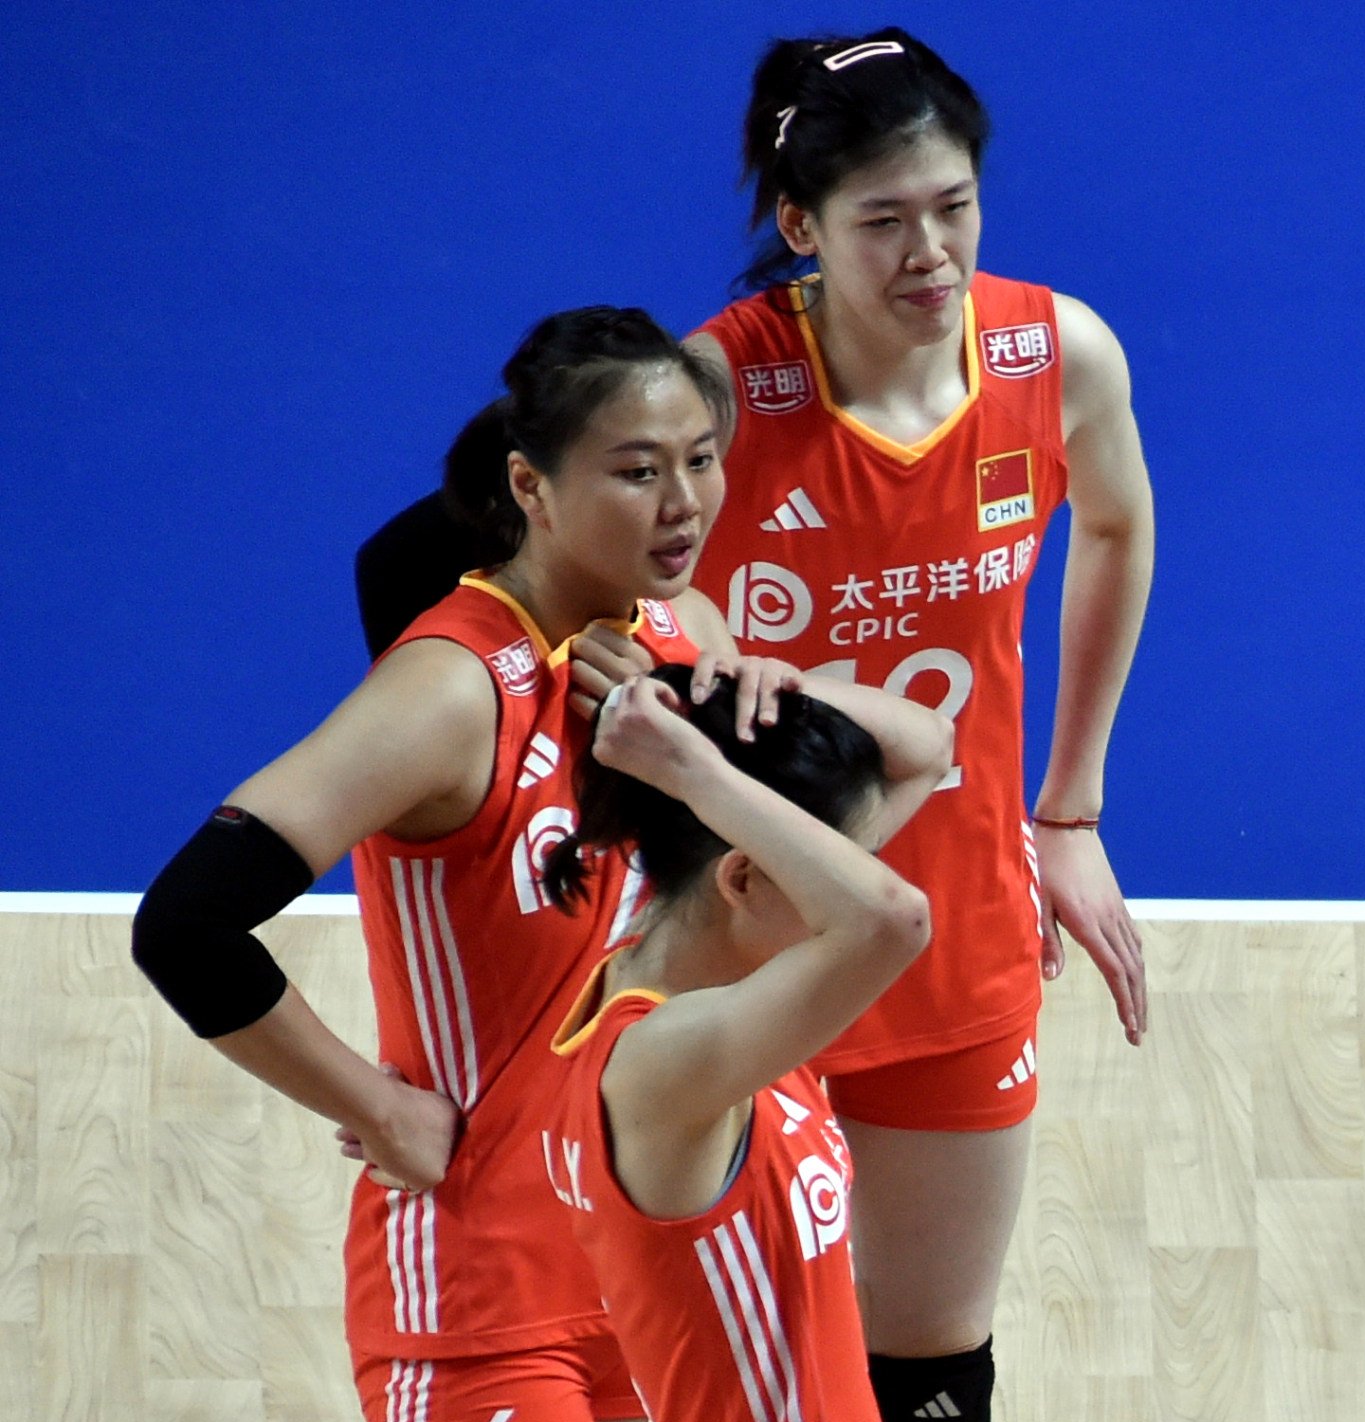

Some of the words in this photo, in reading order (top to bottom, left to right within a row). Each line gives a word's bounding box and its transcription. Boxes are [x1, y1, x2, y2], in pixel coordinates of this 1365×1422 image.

[986, 327, 1047, 363] 光明
[745, 366, 806, 399] 光明
[984, 499, 1026, 523] CHN
[829, 611, 919, 645] CPIC
